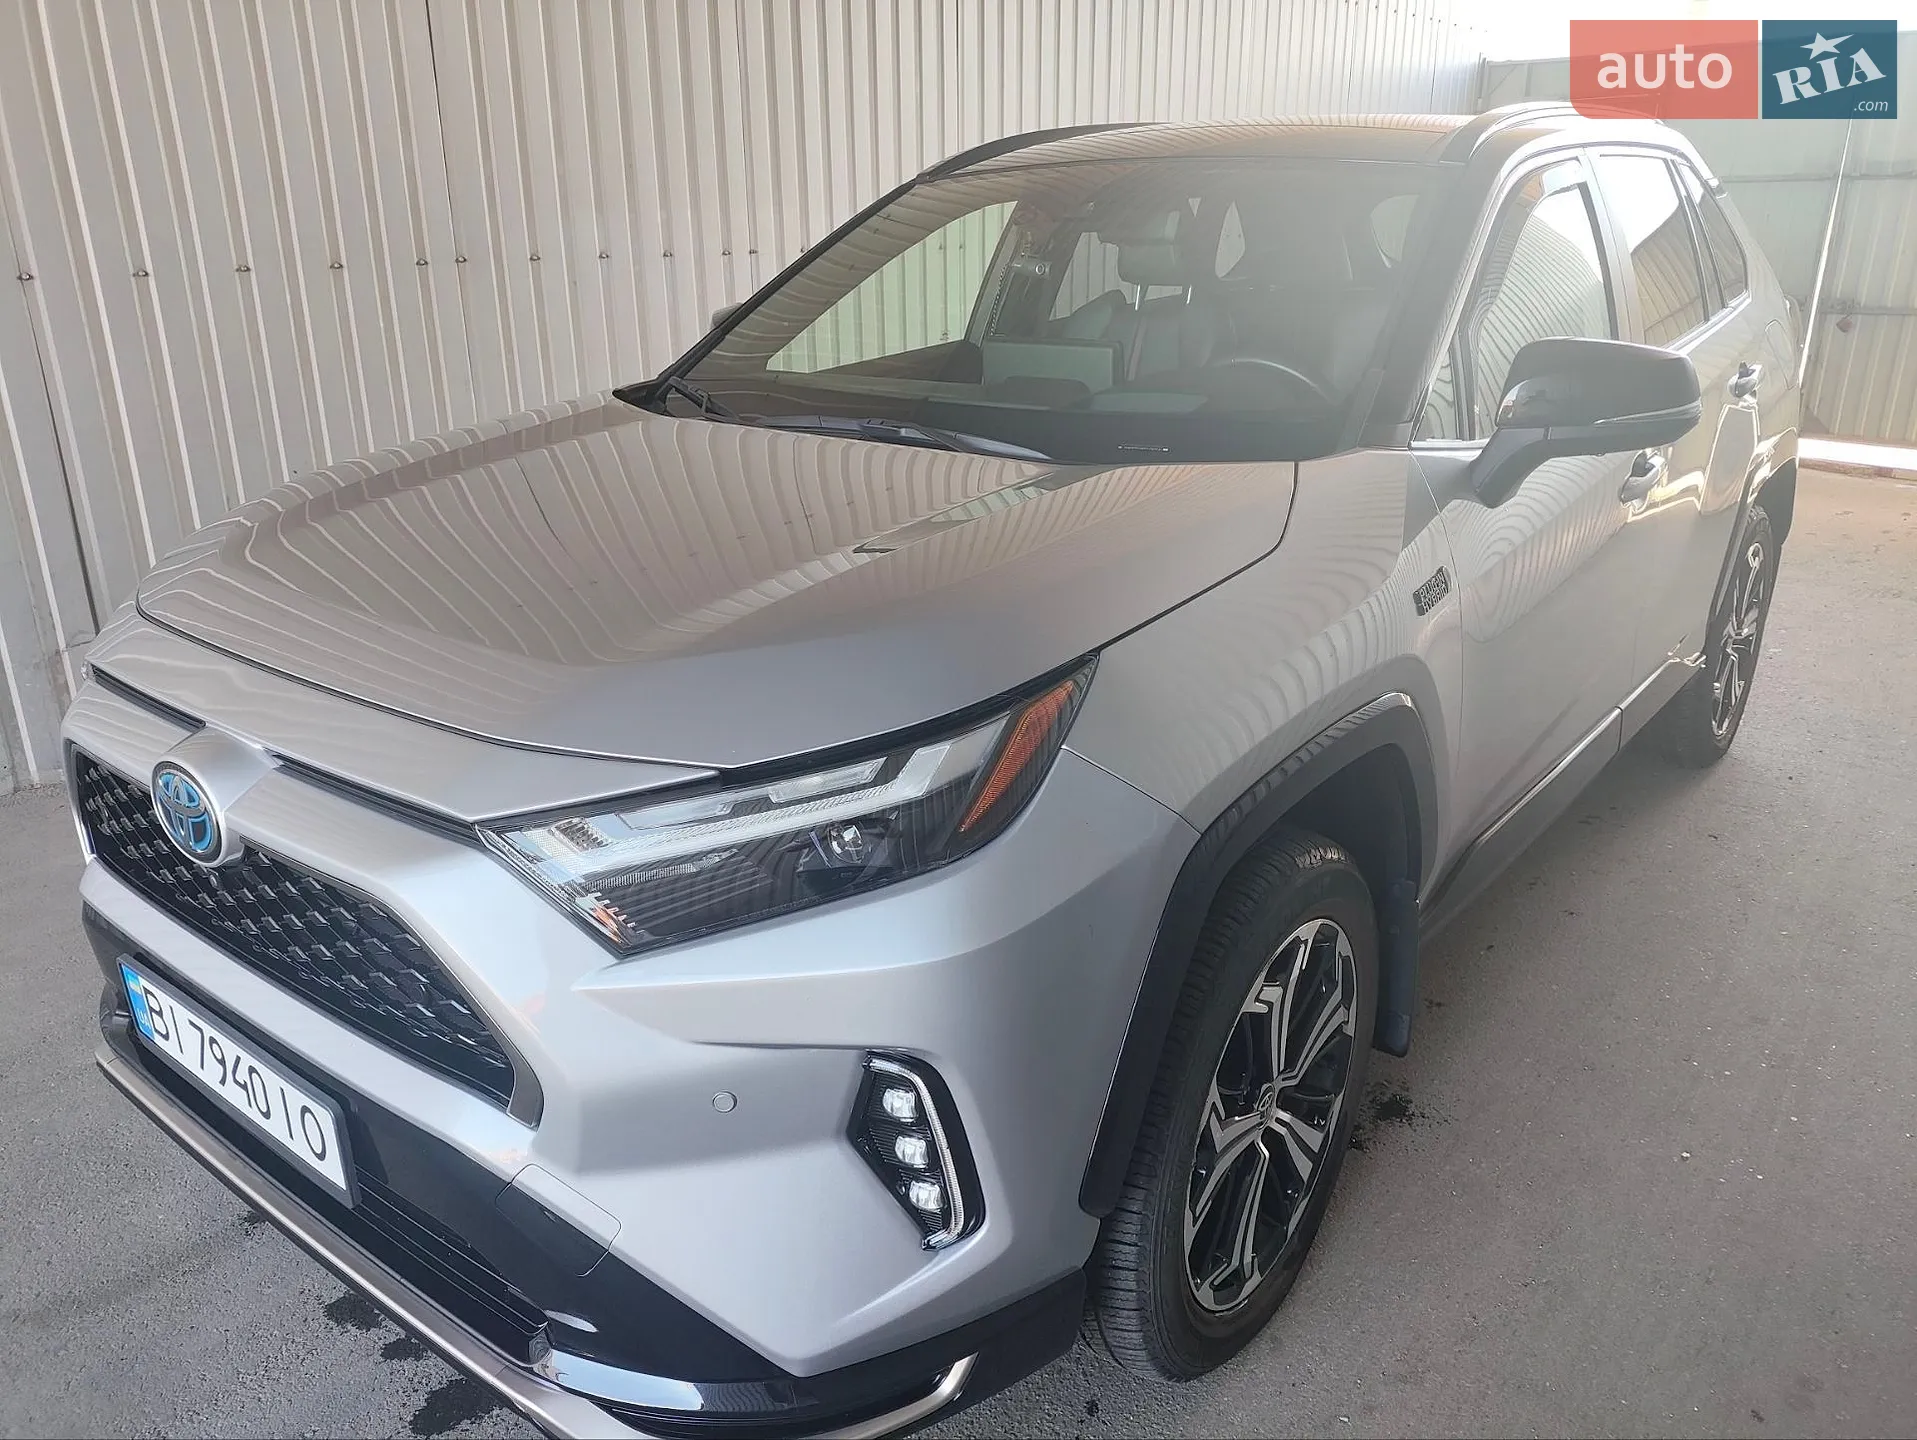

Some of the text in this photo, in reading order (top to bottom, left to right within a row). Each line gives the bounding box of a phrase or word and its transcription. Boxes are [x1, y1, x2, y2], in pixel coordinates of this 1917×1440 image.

[142, 985, 327, 1162] BI 7940 IO
